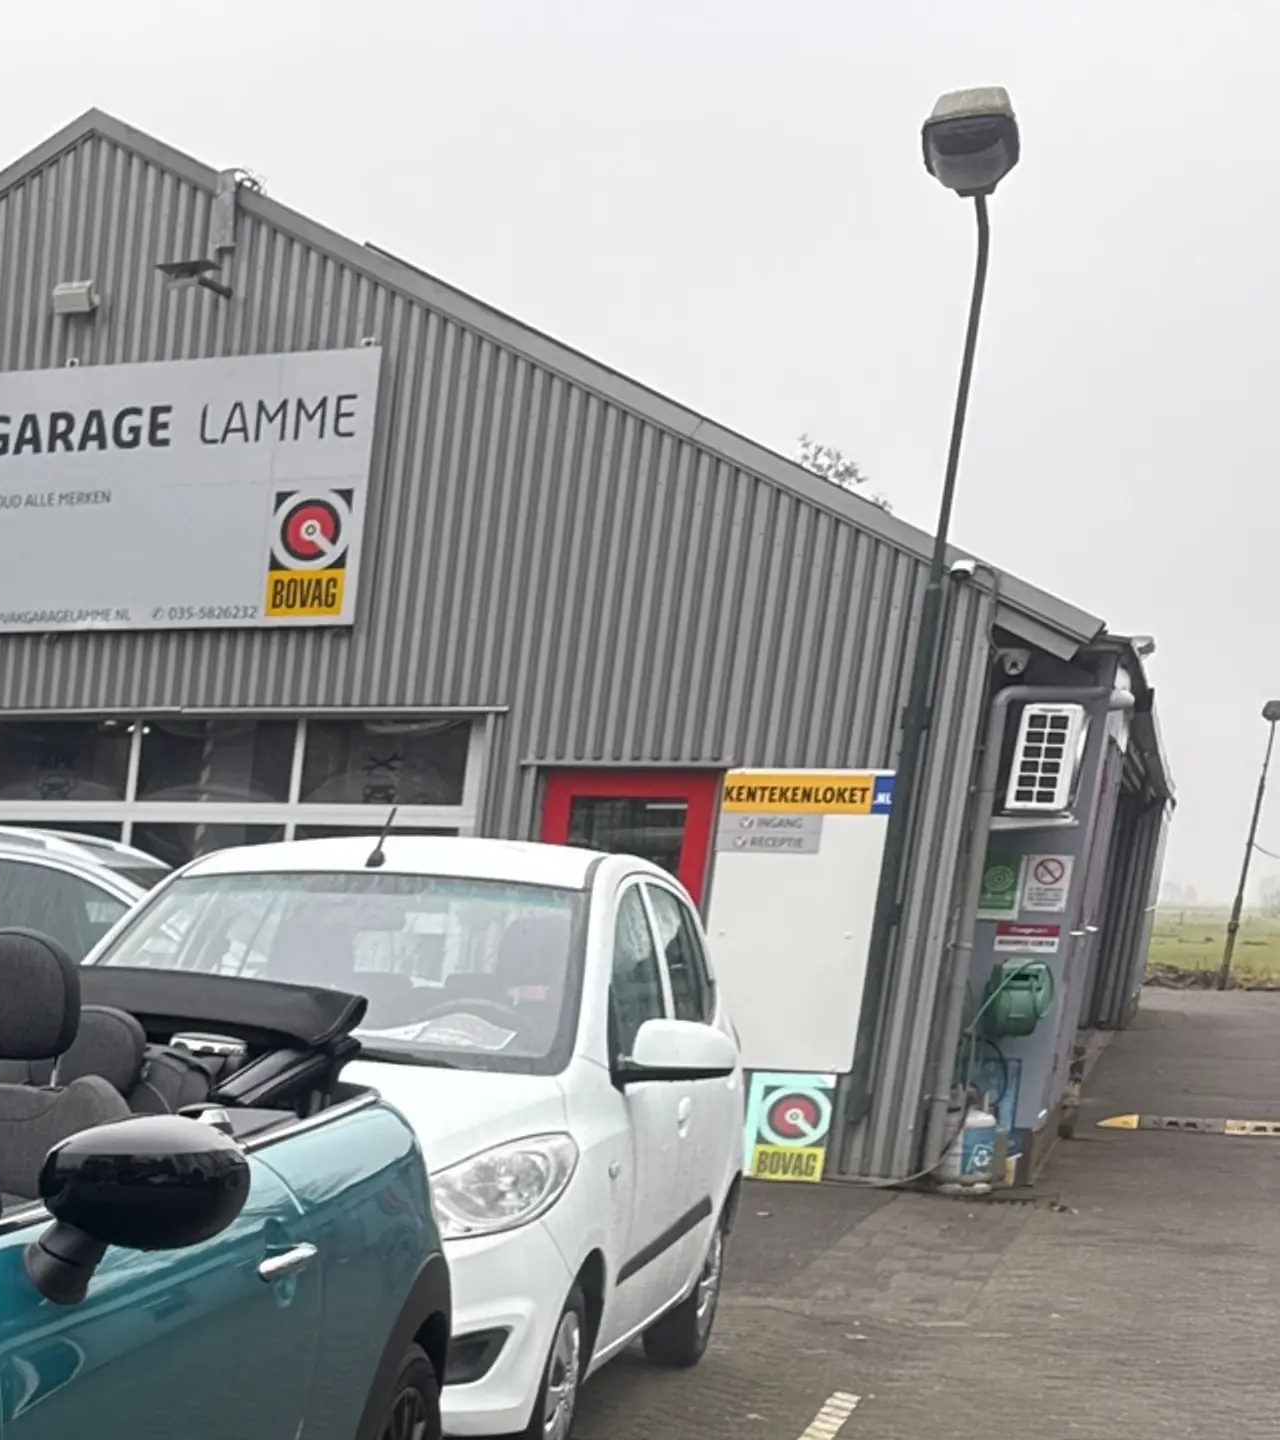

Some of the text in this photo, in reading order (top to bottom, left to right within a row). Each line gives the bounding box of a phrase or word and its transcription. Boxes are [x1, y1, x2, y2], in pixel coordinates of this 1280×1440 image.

[200, 394, 358, 444] LAMME
[24, 492, 55, 508] ALLE
[58, 490, 111, 507] MERKEN
[271, 577, 338, 609] BOVAG
[168, 606, 258, 620] 035-5826232
[723, 785, 870, 804] KENTEKENLOKET
[756, 817, 803, 829] INGANG
[750, 836, 804, 848] RECEPTIE
[756, 1150, 817, 1177] BOVAG
